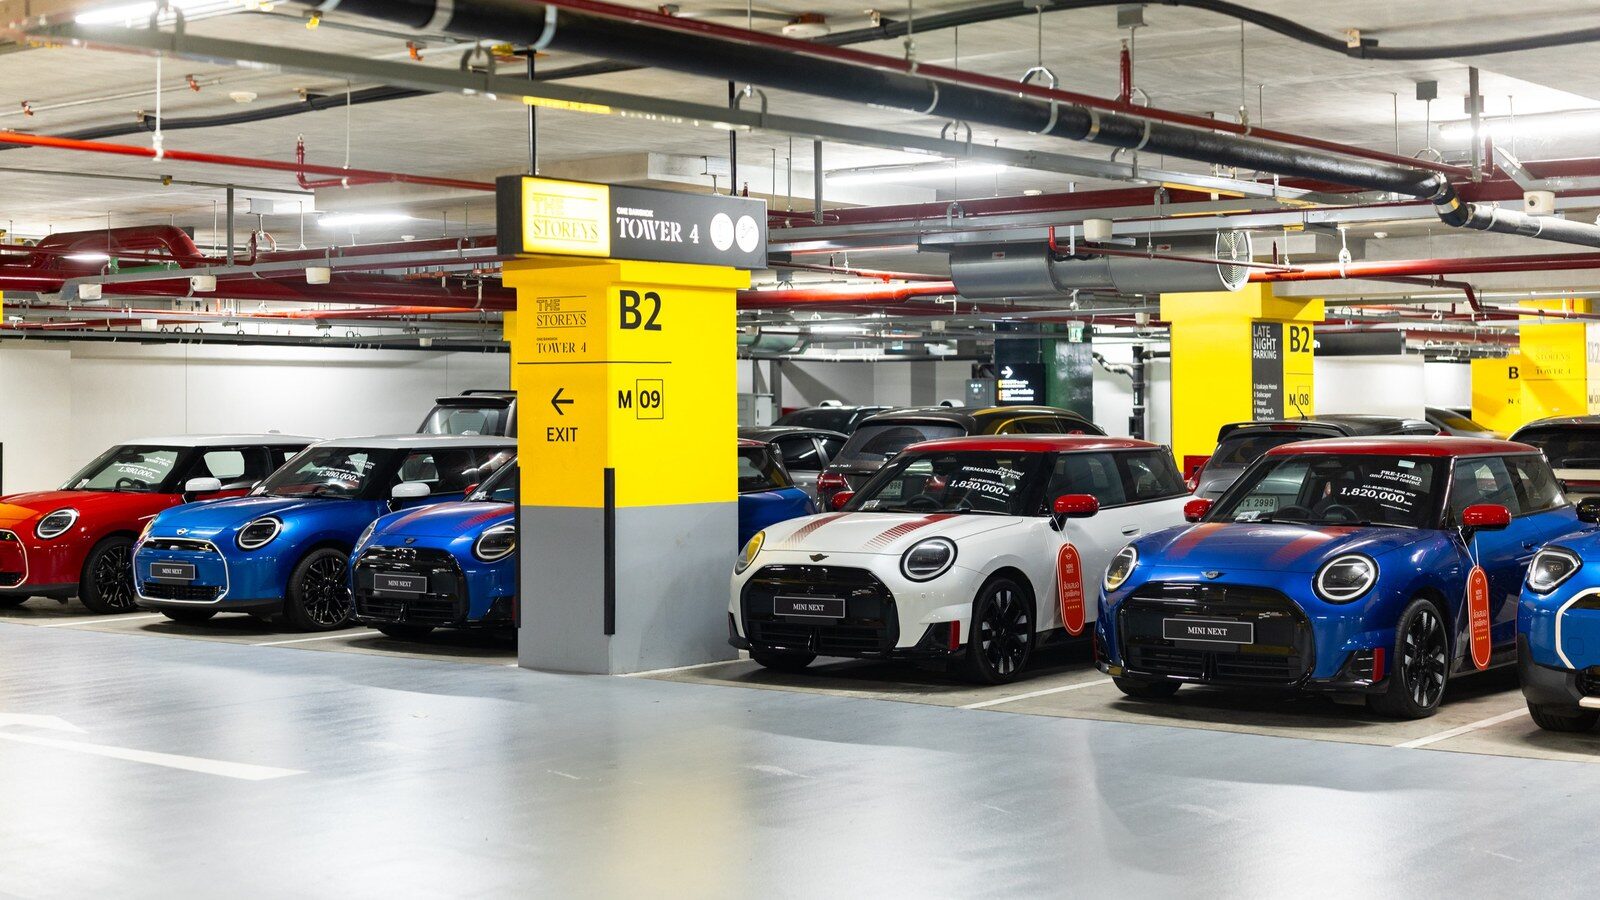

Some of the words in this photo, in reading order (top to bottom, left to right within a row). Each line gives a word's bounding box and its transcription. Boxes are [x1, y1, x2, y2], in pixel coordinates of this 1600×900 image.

[534, 218, 599, 240] STOREYS
[616, 217, 683, 243] TOWER
[689, 224, 700, 244] 4
[536, 299, 560, 312] THE
[620, 290, 662, 331] B2
[536, 313, 587, 327] STOREYS
[1253, 325, 1271, 338] LATE
[1253, 338, 1276, 350] NIGHT
[1290, 326, 1310, 353] B2
[536, 342, 576, 354] TOWER
[580, 342, 586, 353] 4
[1253, 350, 1277, 359] PARKING
[618, 390, 632, 408] M
[639, 390, 661, 409] 09
[1289, 394, 1296, 406] M
[1300, 394, 1309, 406] 08
[546, 427, 578, 442] EXIT
[316, 470, 356, 481] 1,380,000
[962, 466, 1006, 476] PERMANENTLY
[949, 480, 1003, 495] 1,820,000
[1340, 487, 1404, 503] 1,820,000
[1254, 499, 1274, 507] 2999
[1188, 626, 1206, 635] MINI
